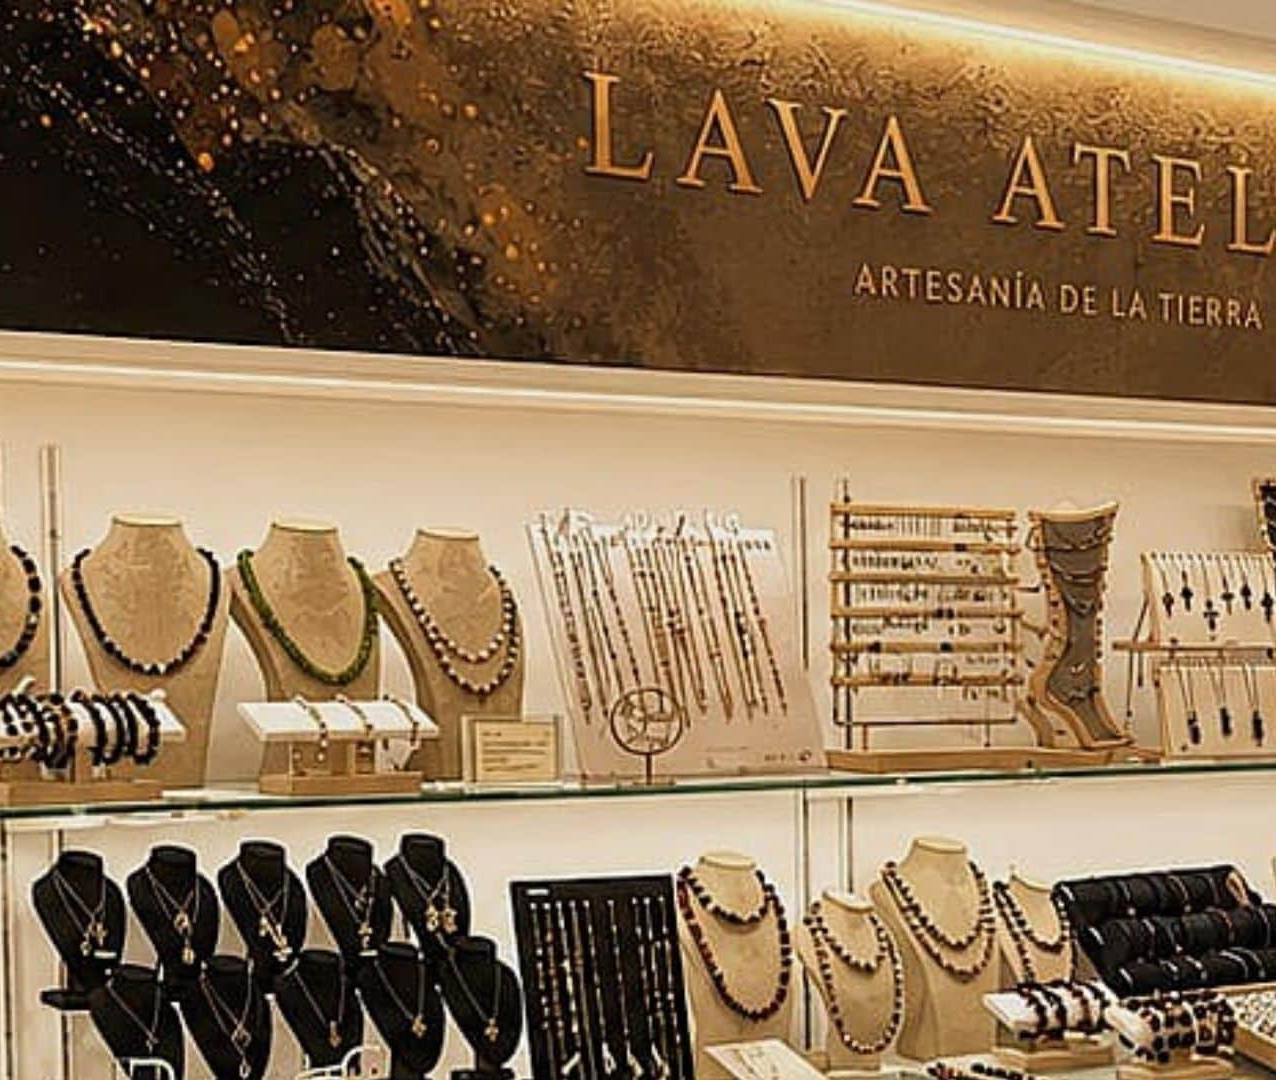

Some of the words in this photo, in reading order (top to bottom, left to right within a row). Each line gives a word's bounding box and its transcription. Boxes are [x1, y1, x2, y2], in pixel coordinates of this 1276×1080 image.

[582, 70, 932, 214] LAVA
[854, 263, 1046, 310] ARTESANÍA
[1059, 284, 1097, 317] DE
[1112, 289, 1147, 320] LA
[1159, 292, 1264, 330] TIERRA
